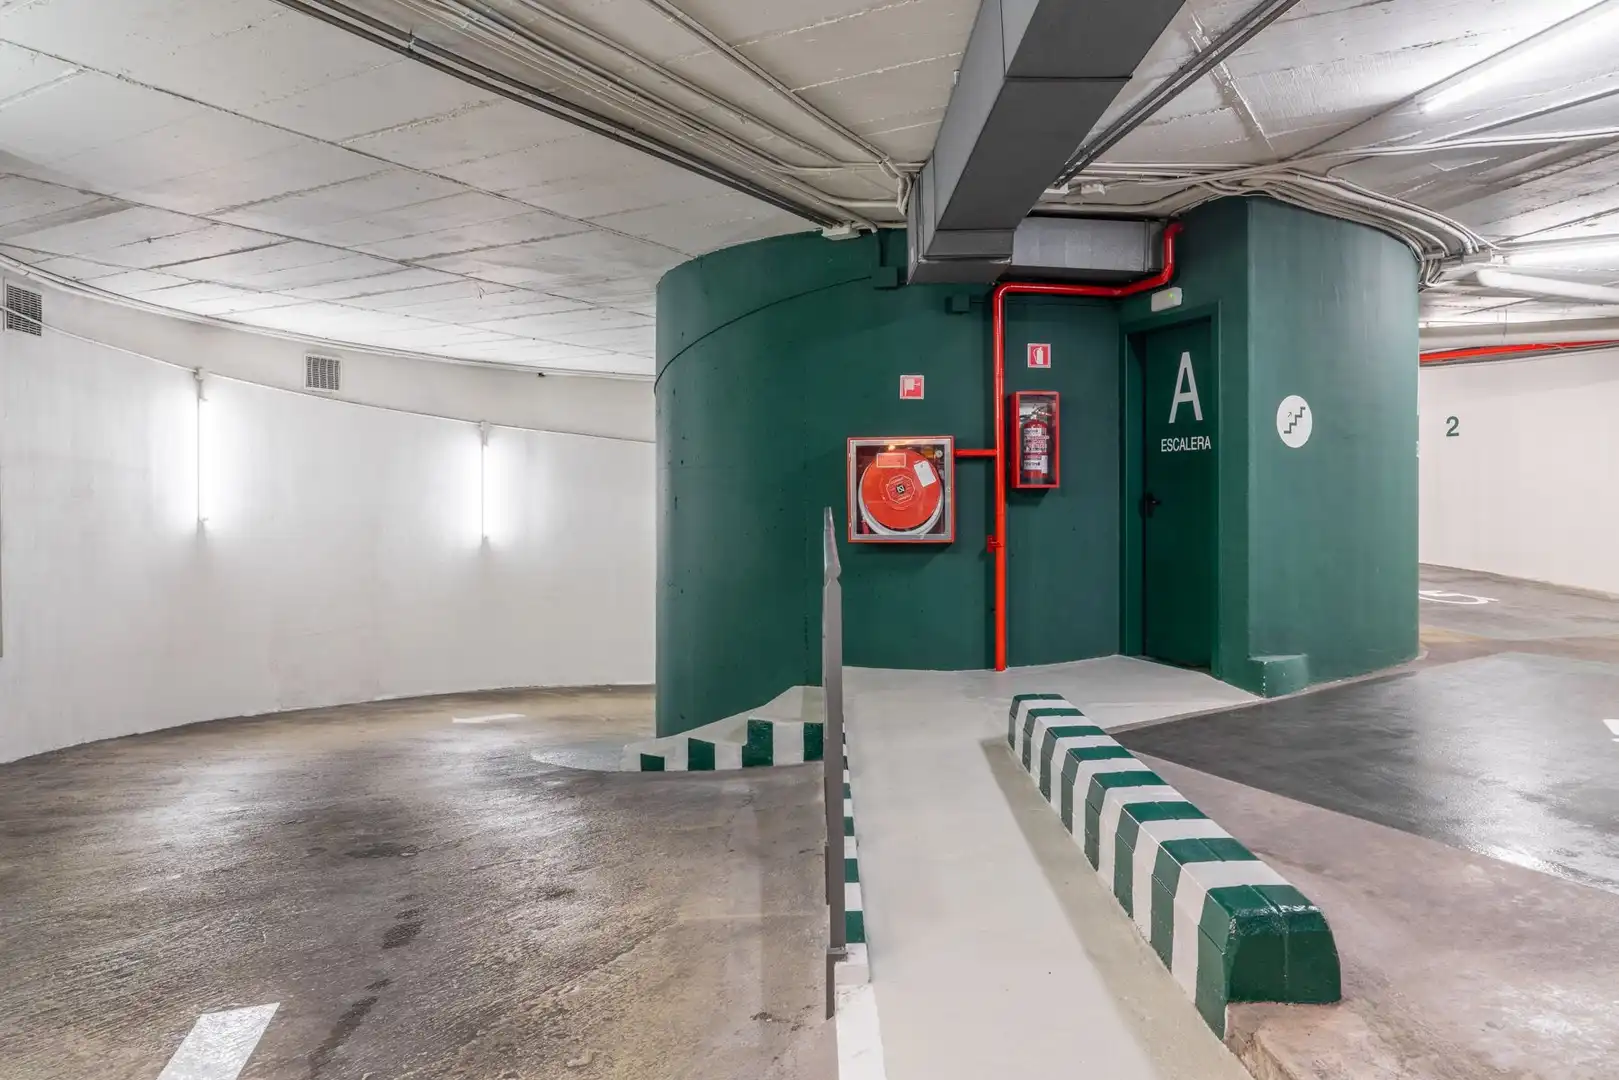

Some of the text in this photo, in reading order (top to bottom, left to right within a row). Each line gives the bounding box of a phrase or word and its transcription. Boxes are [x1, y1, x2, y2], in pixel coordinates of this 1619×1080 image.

[1168, 351, 1203, 424] A
[1446, 415, 1460, 437] 2
[1160, 435, 1212, 452] ESCALERA
